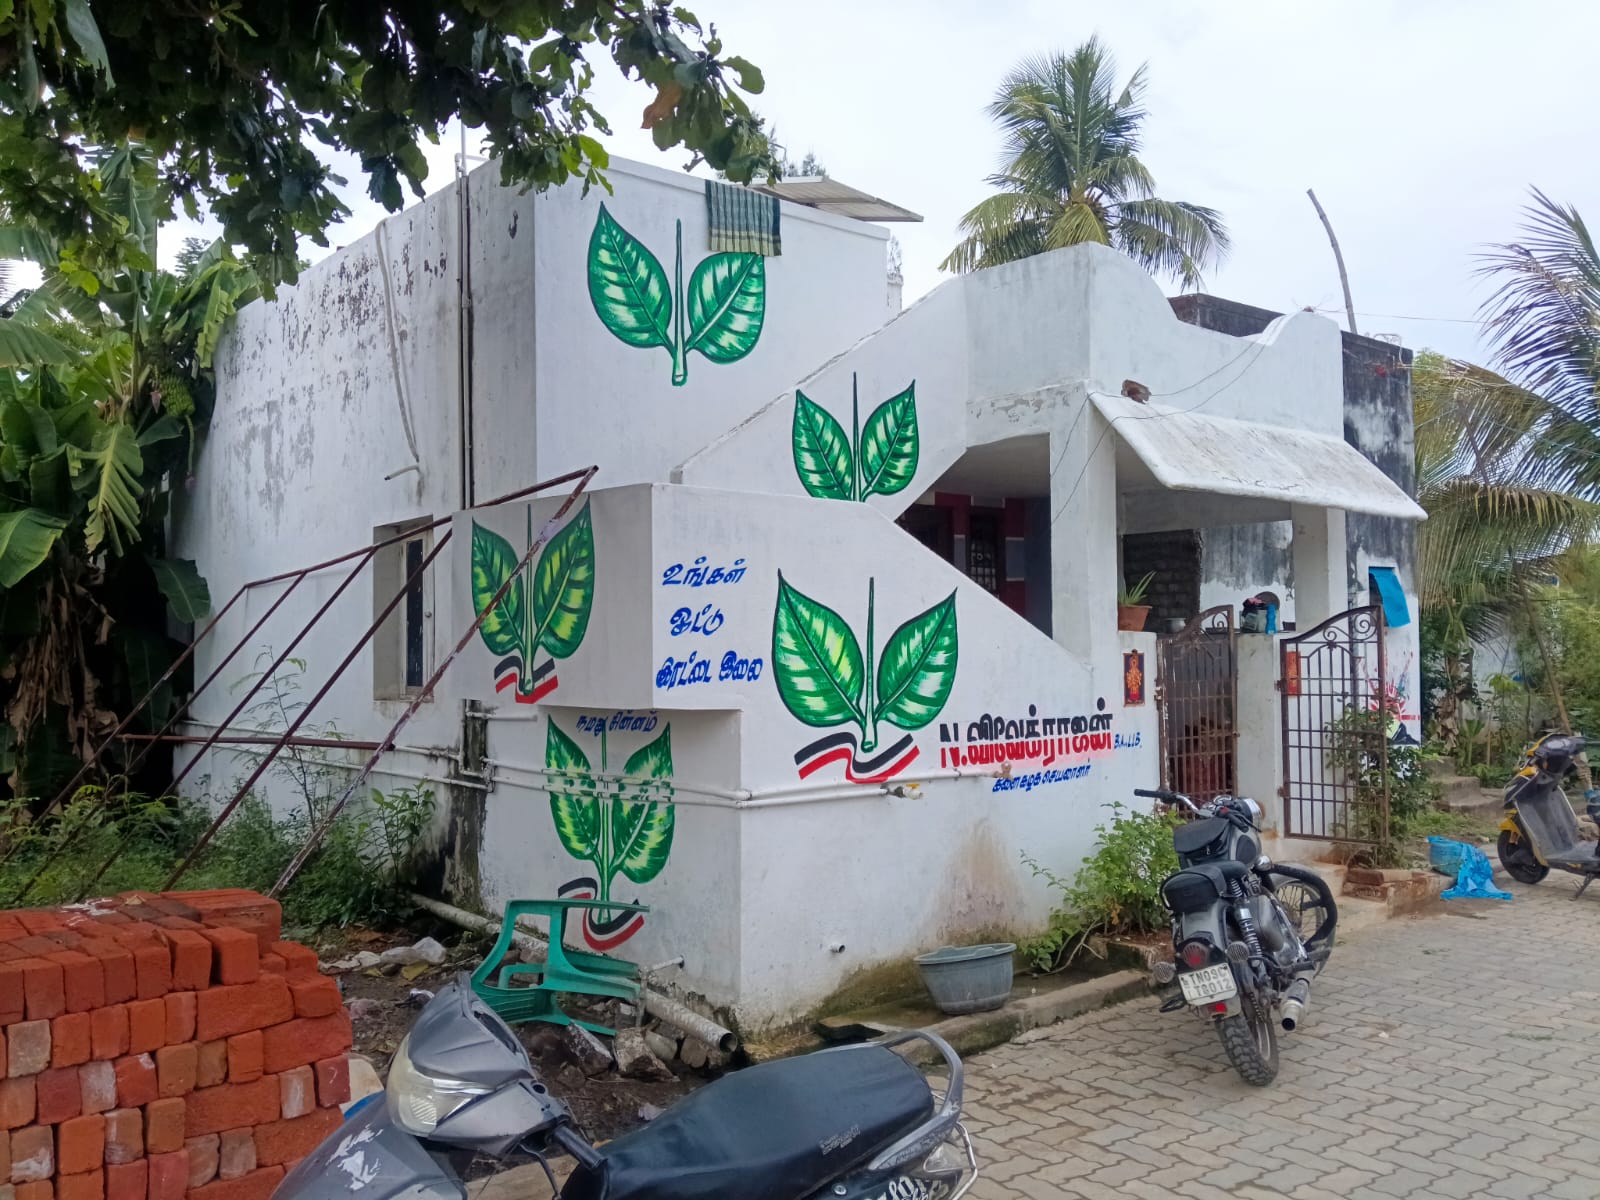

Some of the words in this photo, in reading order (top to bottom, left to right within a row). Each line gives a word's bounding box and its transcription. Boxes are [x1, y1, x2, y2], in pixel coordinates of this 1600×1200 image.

[662, 556, 747, 587] உங்கள்
[656, 650, 713, 691] இரட்டை
[718, 650, 763, 682] இலை
